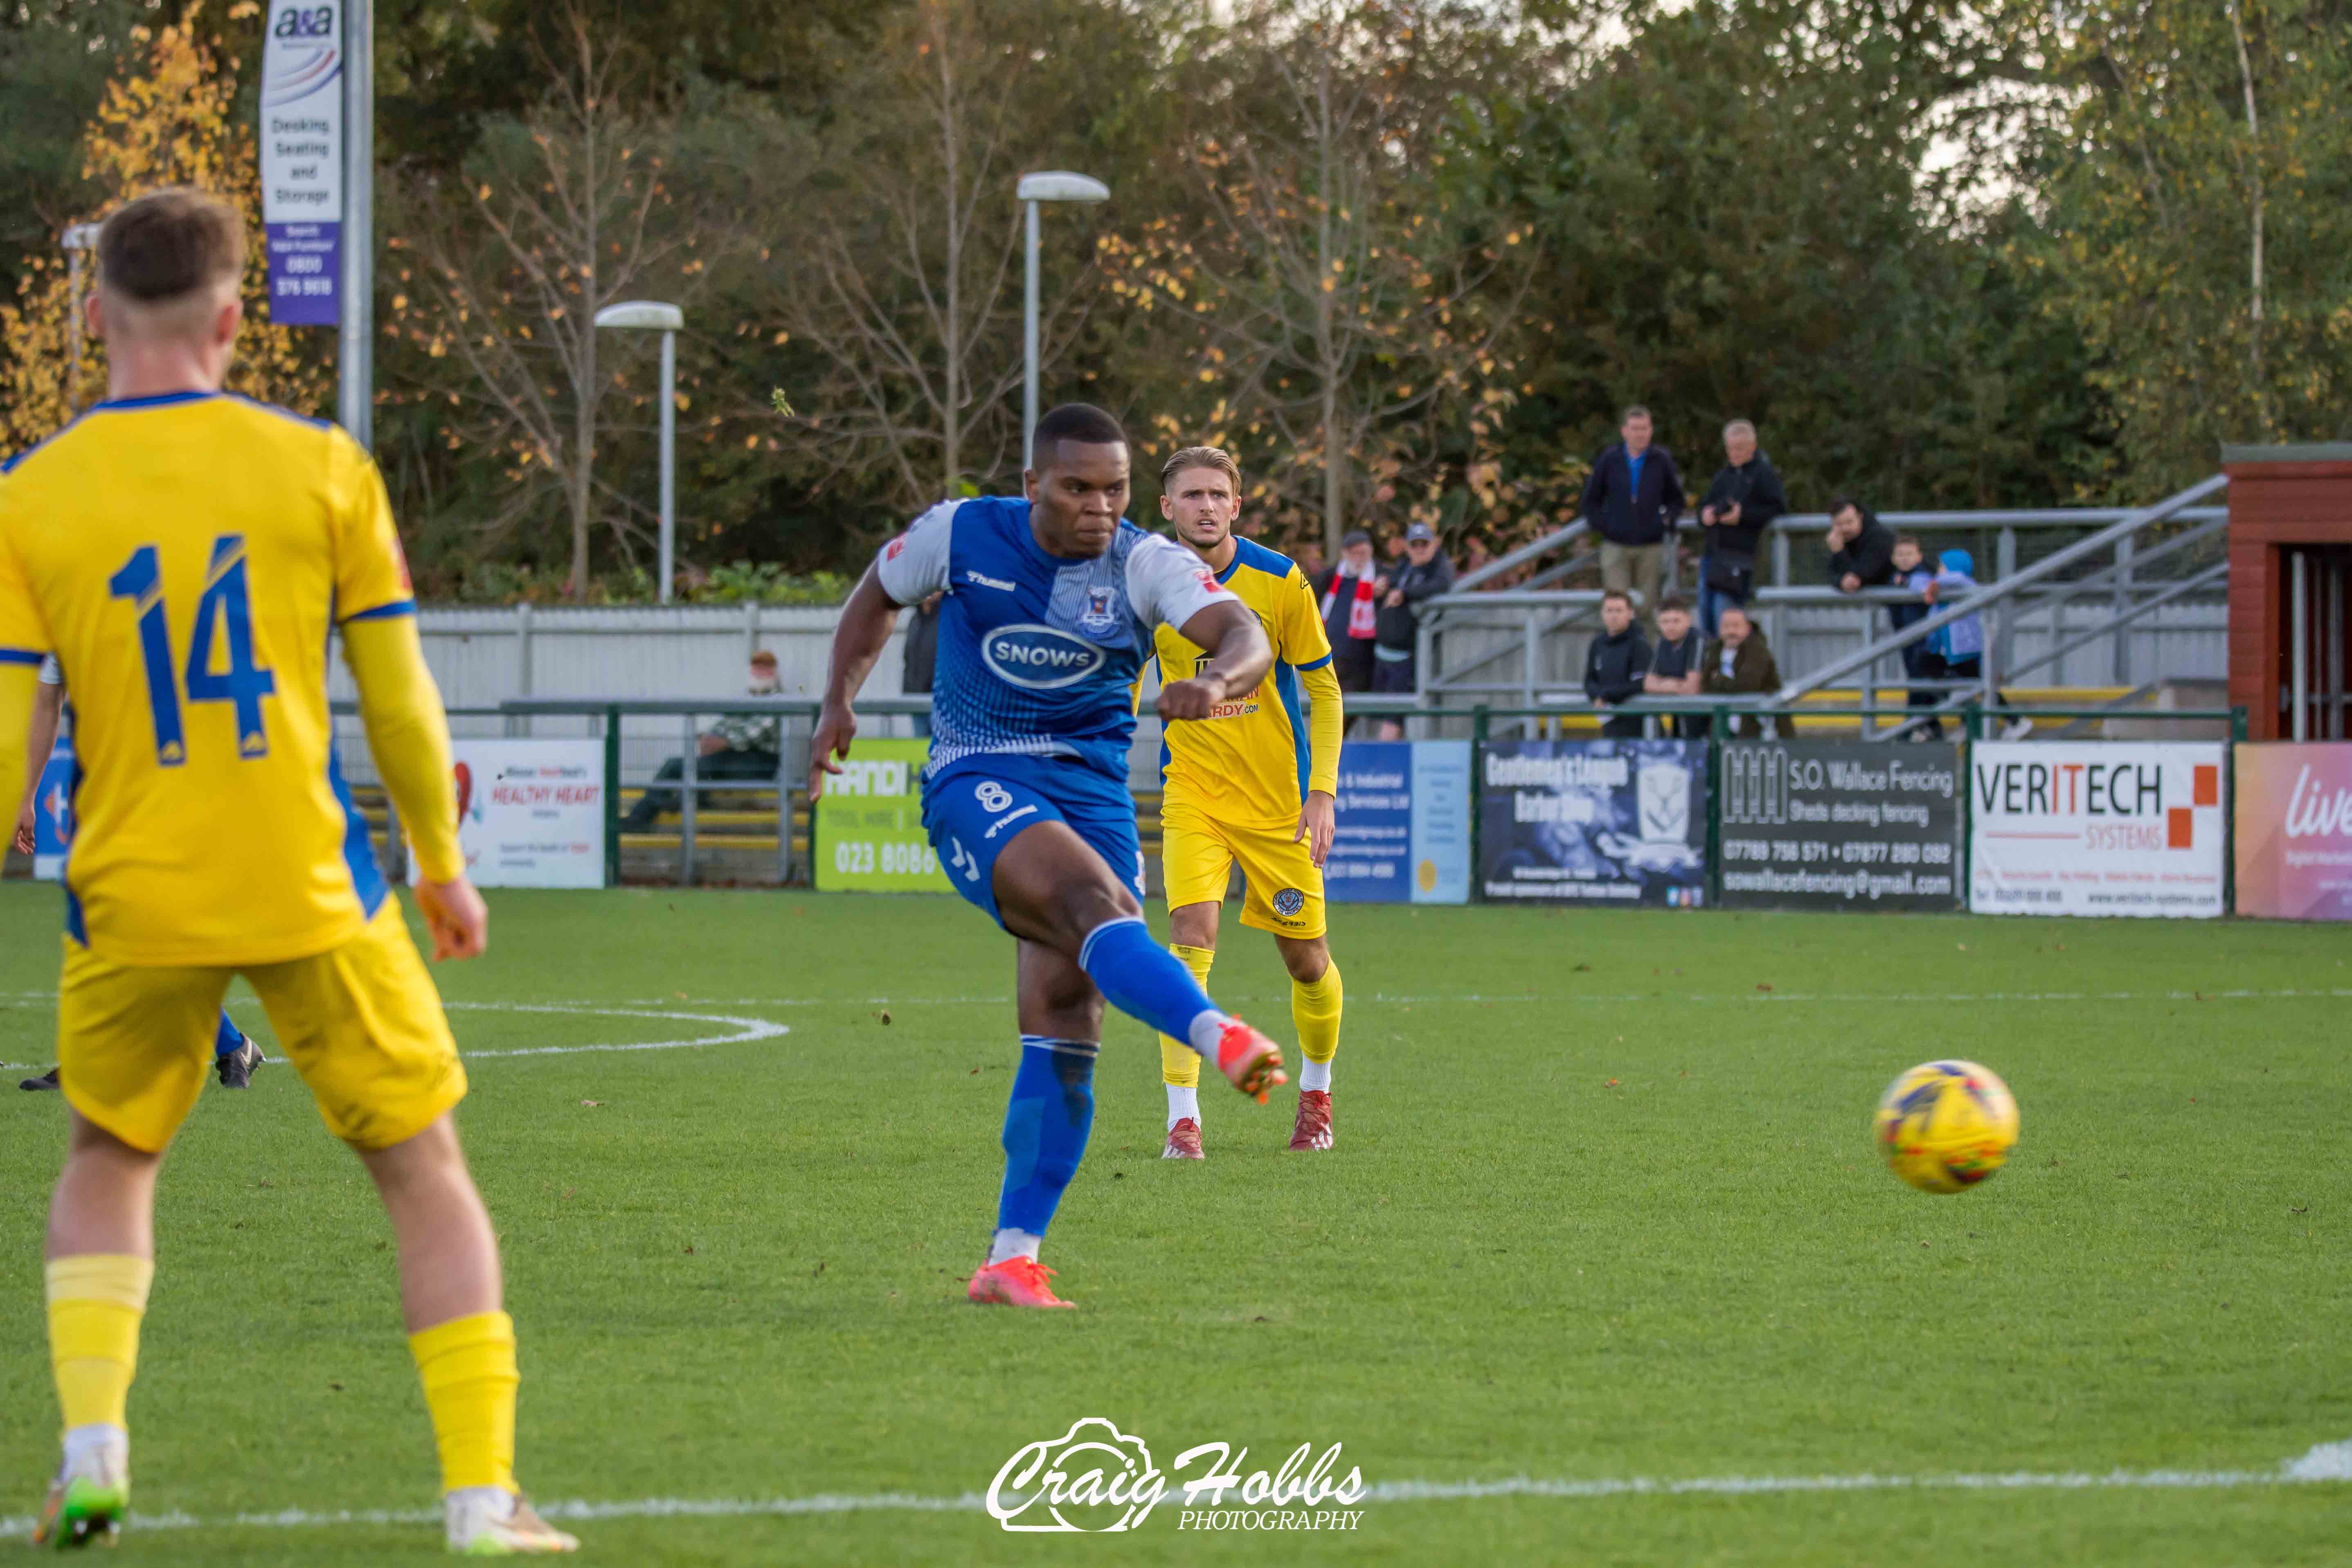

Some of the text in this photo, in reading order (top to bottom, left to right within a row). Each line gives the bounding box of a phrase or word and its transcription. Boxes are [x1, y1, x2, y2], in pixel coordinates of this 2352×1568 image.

[274, 6, 332, 38] a&a
[108, 534, 275, 766] 14
[995, 641, 1090, 667] SNOWS
[1826, 760, 1887, 791] Wallace
[1889, 759, 1953, 798] Fencing
[1977, 763, 2162, 815] VERITECH
[974, 780, 1013, 813] 8
[2086, 825, 2162, 851] SYSTEMS
[835, 841, 874, 874] 023
